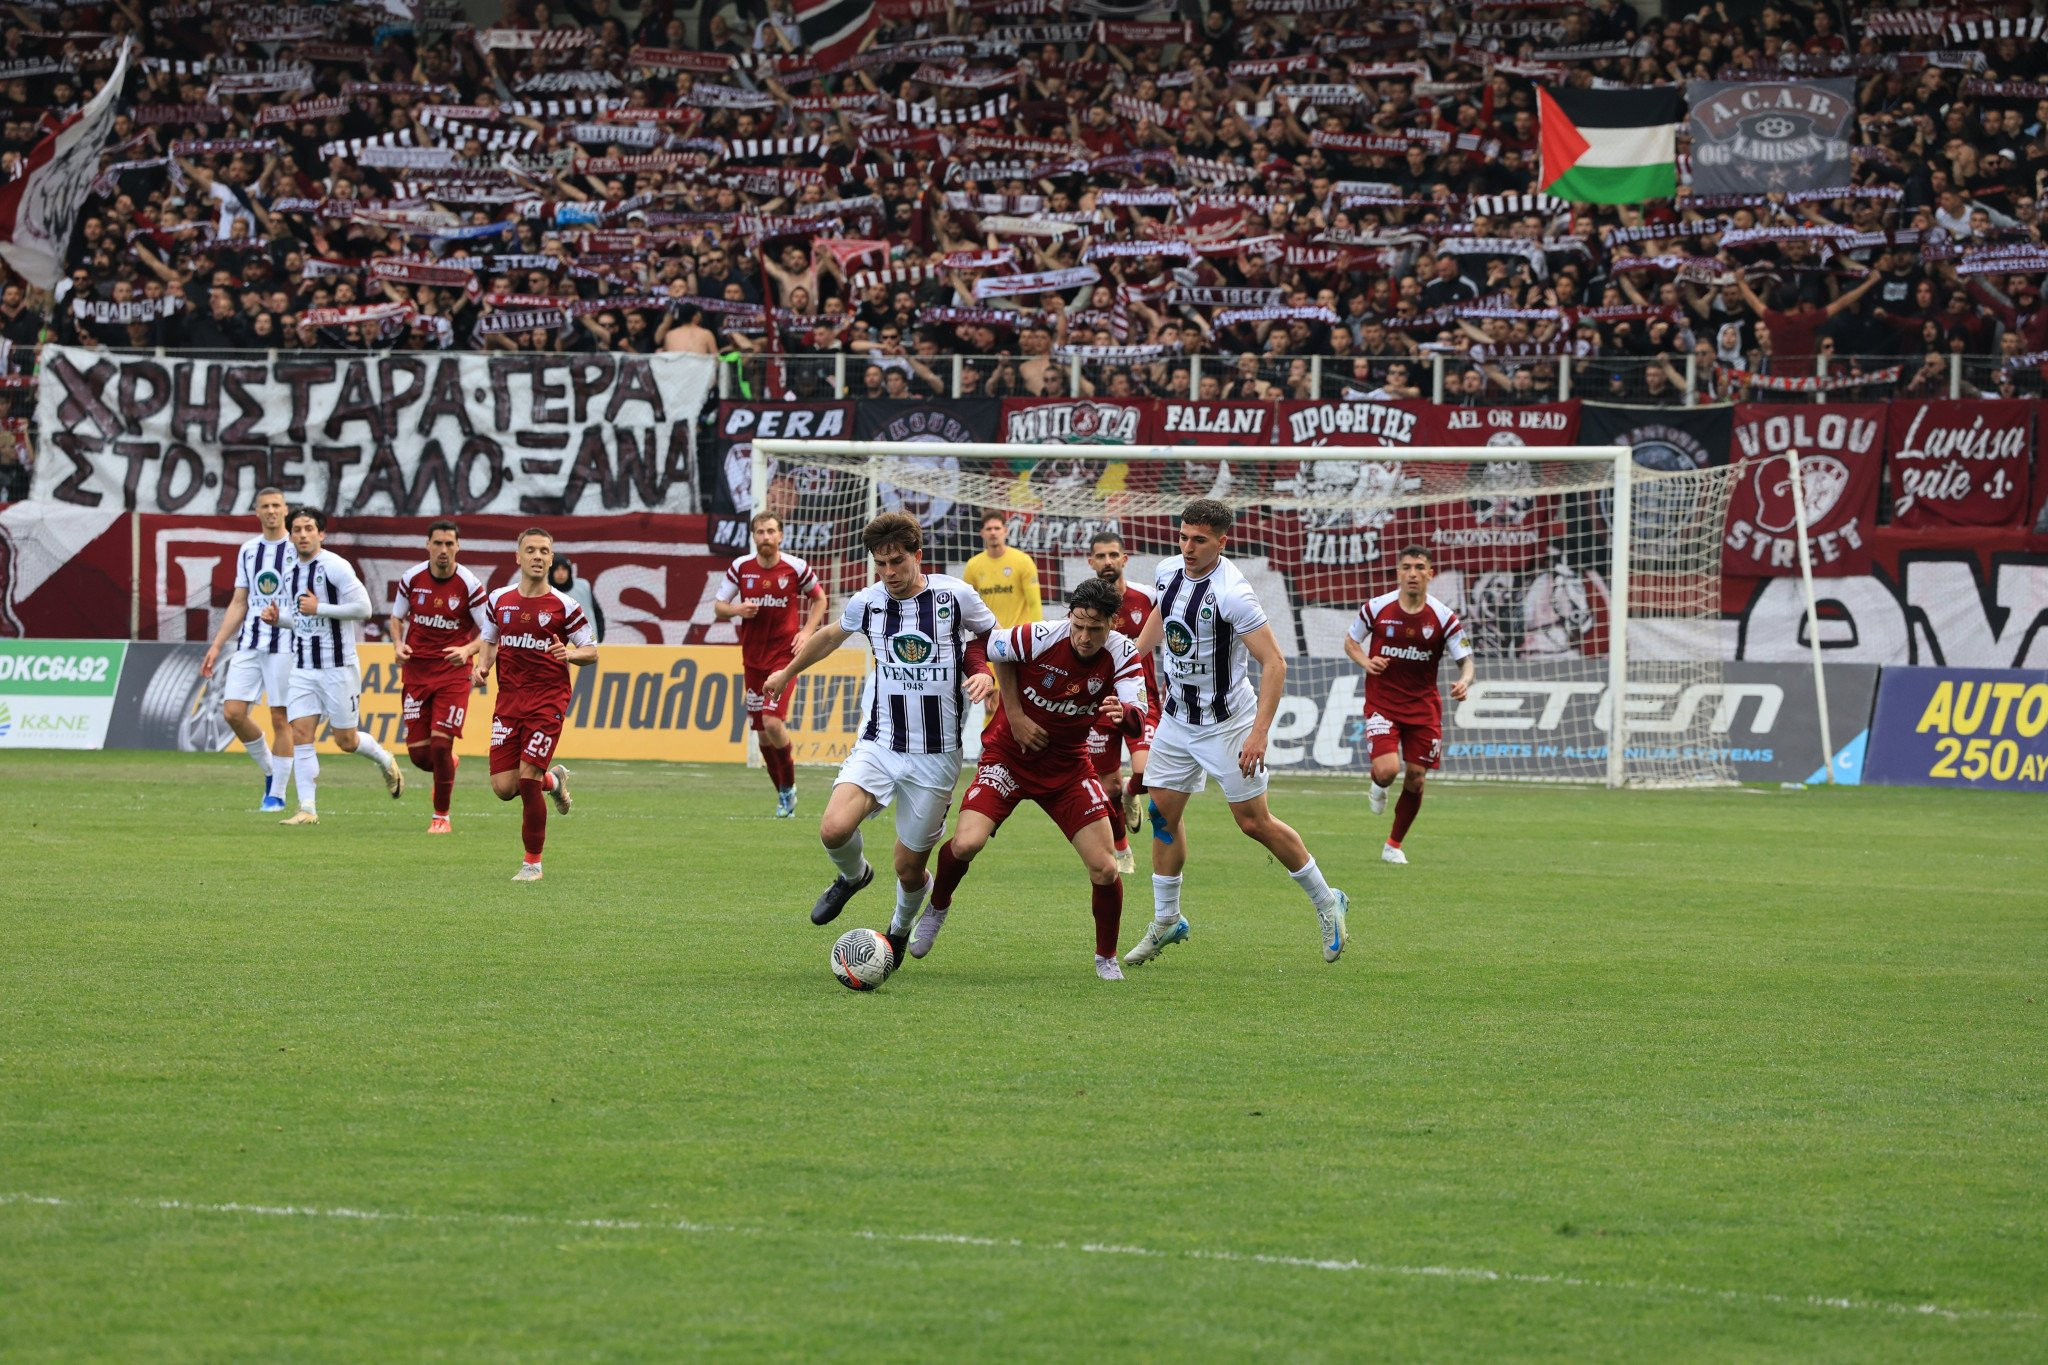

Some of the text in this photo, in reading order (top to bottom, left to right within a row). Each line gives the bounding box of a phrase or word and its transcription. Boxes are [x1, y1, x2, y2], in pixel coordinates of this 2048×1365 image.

[1712, 89, 1836, 124] A.C.A.B.
[480, 311, 545, 331] LARISSA
[725, 408, 845, 438] PERA
[1164, 404, 1266, 433] FALANI
[1289, 402, 1417, 443] ΠΡΟΦΗΤΗΣ
[1447, 408, 1568, 430] AEL OR DEAD
[1895, 404, 2026, 460] Larissa
[1735, 414, 1877, 456] VOLOU
[1894, 460, 1971, 517] gate
[1381, 646, 1433, 661] novibet
[0, 655, 109, 682] DKC6492
[881, 666, 948, 682] VENETI
[902, 682, 924, 692] 1948
[445, 704, 466, 727] 19
[1023, 686, 1098, 717] novibet
[528, 731, 553, 758] 23
[1449, 743, 1532, 757] EXPERTS
[1537, 744, 1558, 757] IN
[1683, 747, 1773, 762] SYSTEMS
[1929, 737, 2019, 781] 250
